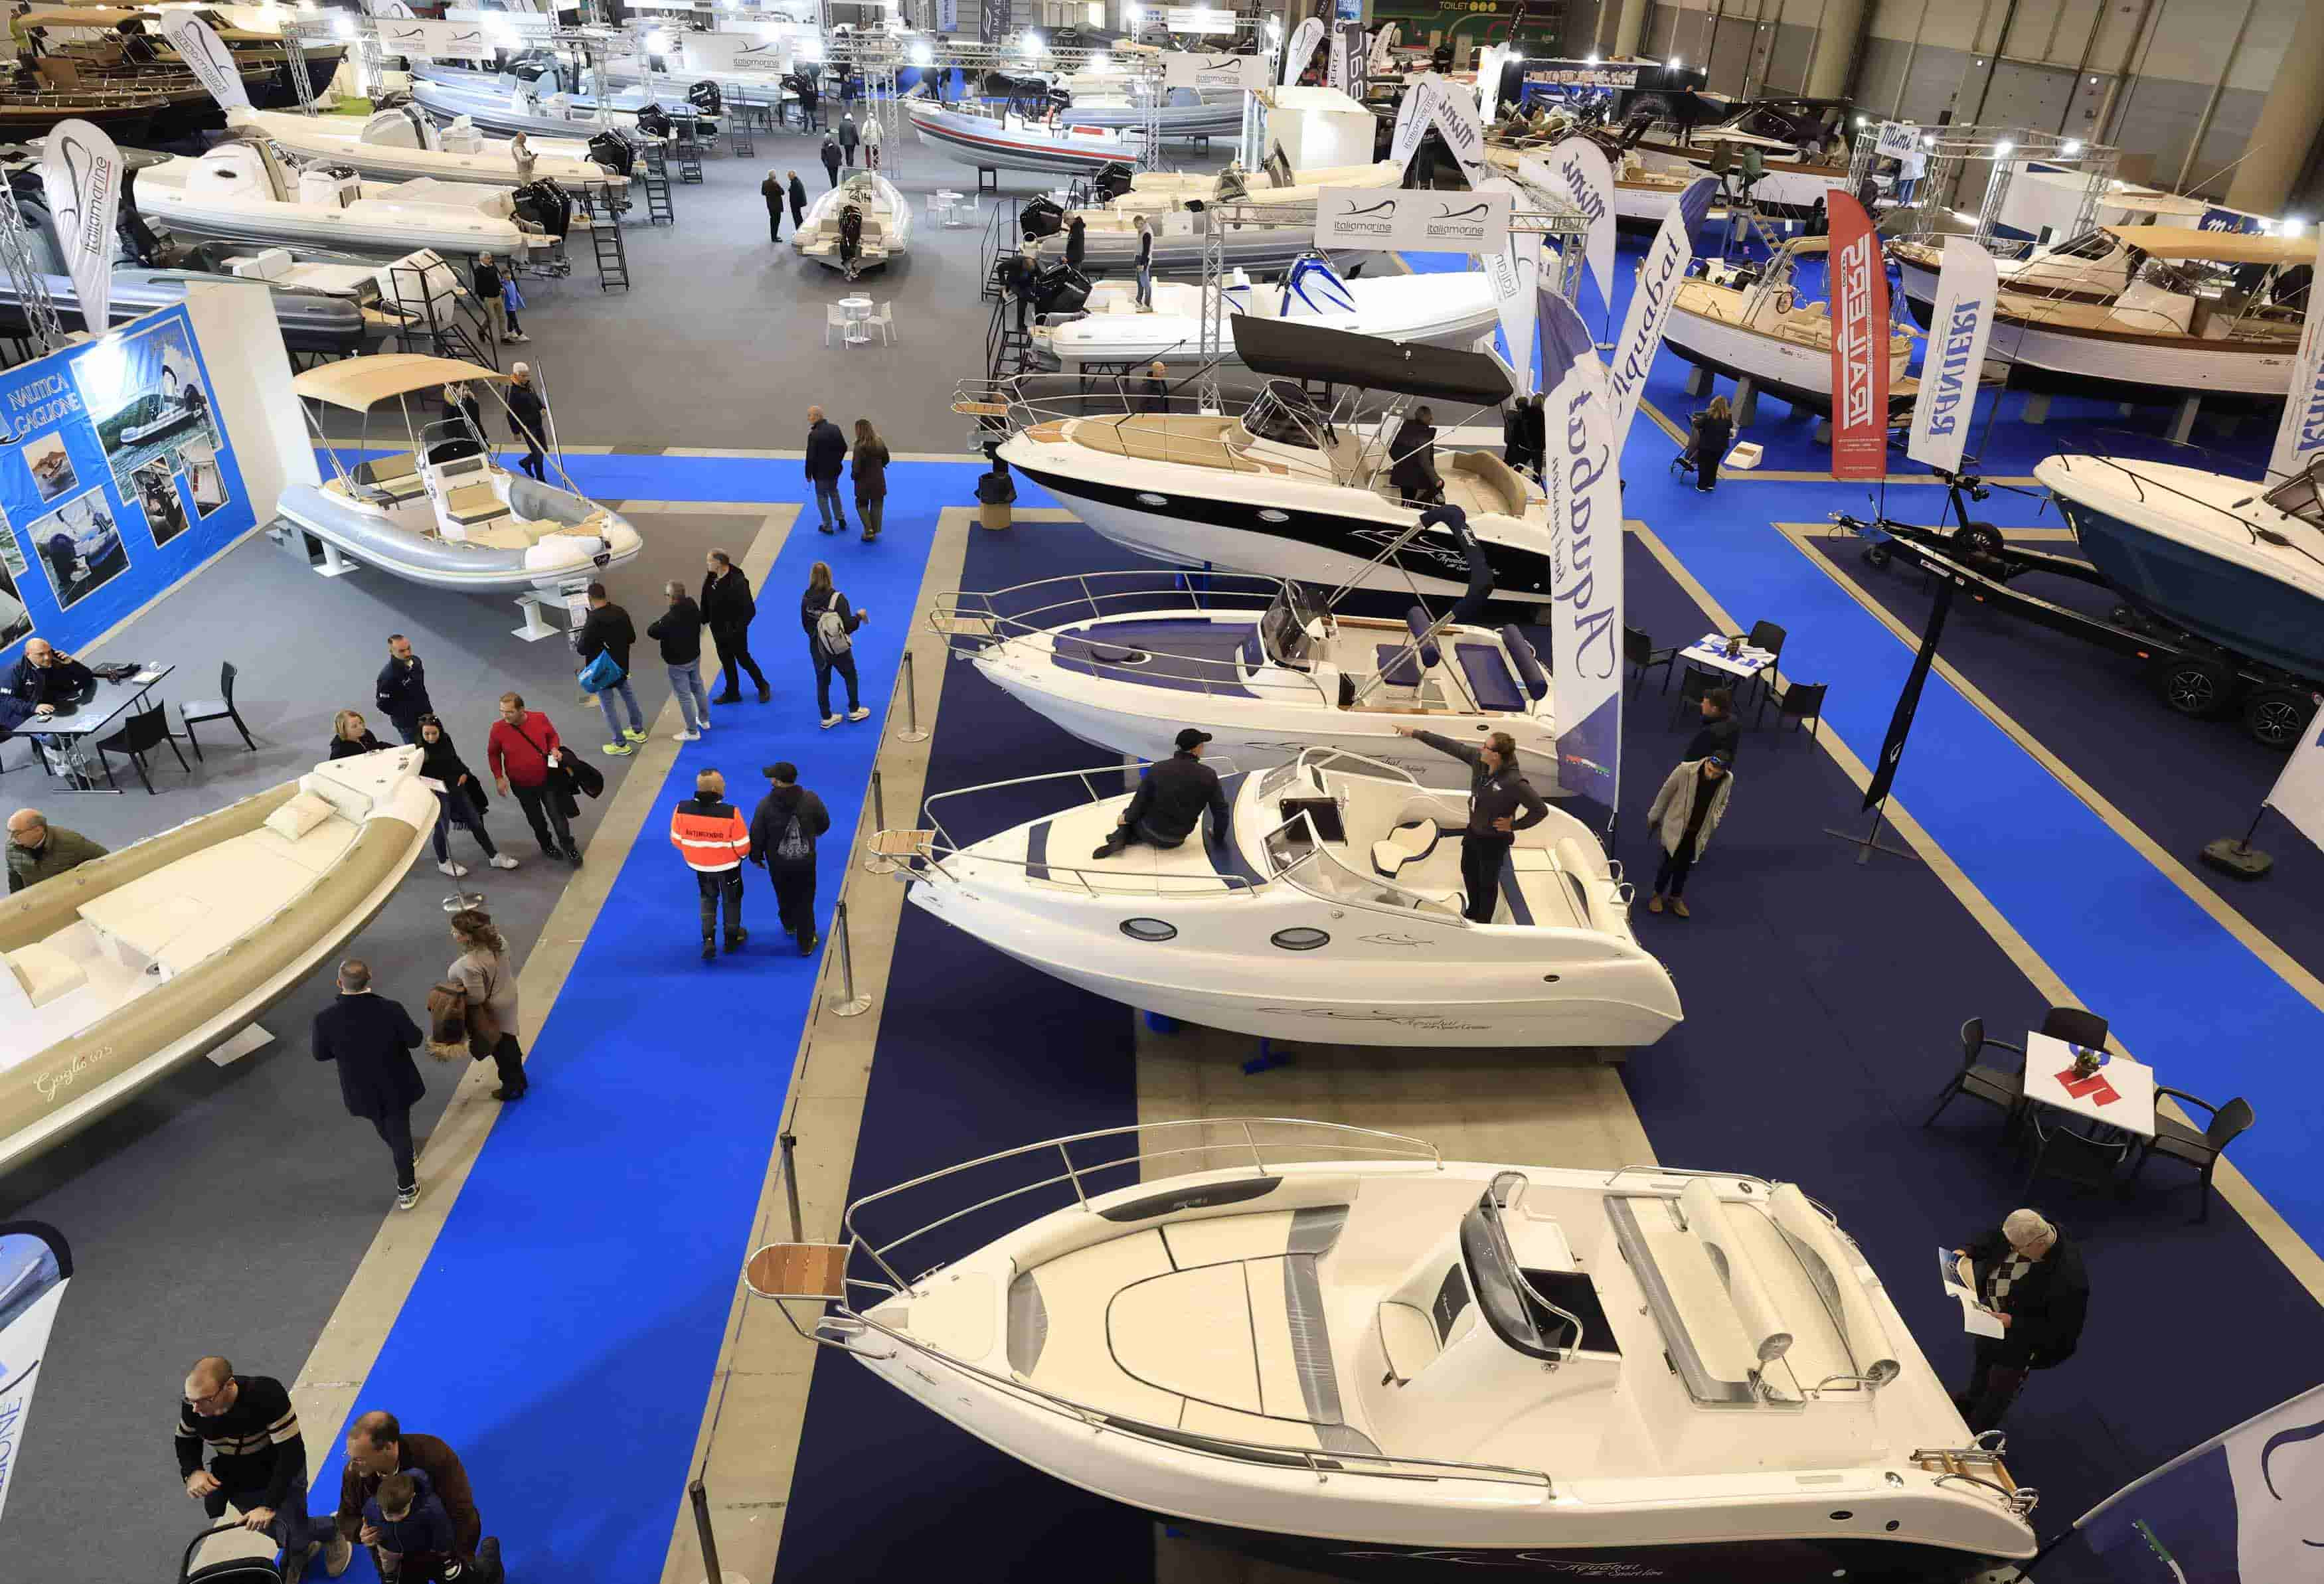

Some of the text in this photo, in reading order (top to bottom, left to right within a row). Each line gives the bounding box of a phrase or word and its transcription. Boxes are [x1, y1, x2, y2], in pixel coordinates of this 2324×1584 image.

[1440, 1, 1468, 11] TOILET
[1610, 231, 1682, 419] Aquabat
[7, 372, 69, 411] NAUTICA
[13, 393, 80, 436] GAGLIONE
